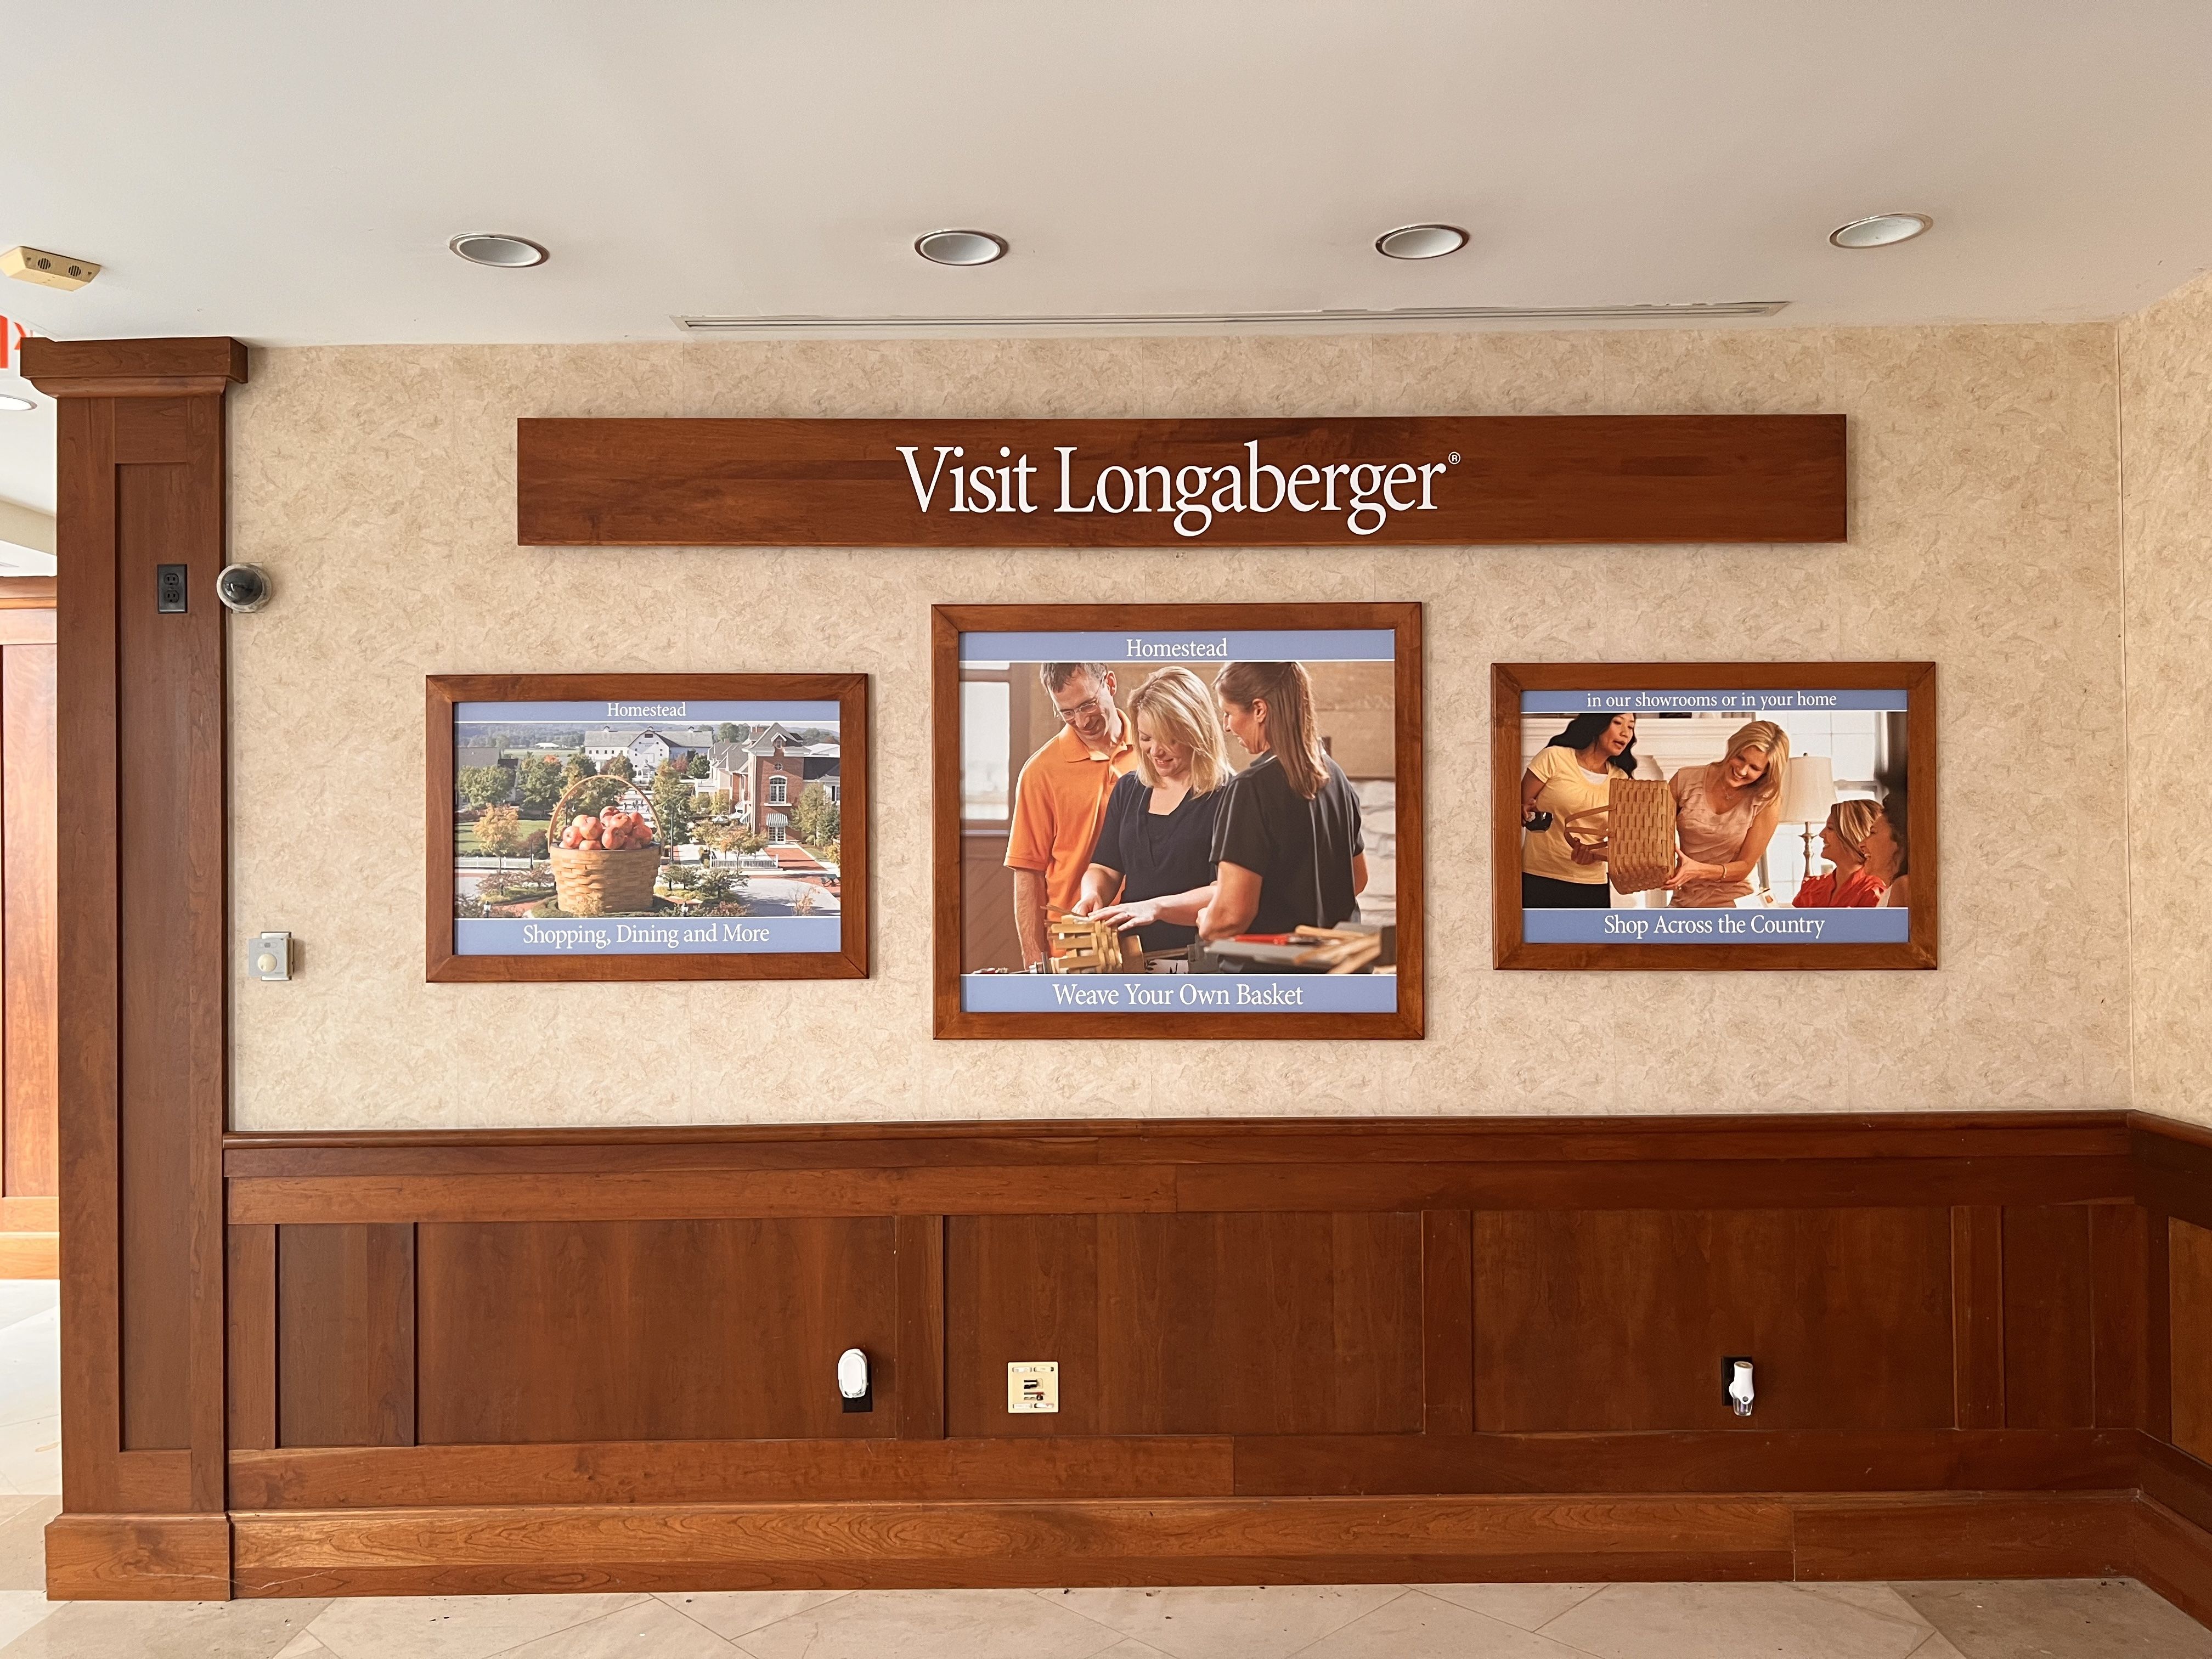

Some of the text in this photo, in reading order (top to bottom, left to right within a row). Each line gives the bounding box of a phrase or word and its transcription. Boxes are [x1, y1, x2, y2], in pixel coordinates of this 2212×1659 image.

[896, 447, 1037, 512] Visit
[1127, 637, 1228, 657] Homestead
[607, 702, 687, 716] Homestead
[1587, 691, 1837, 710] in our showrooms or in your home
[523, 923, 770, 949] Shopping, Dining and More
[1604, 914, 1825, 939] Shop Across the Country
[1052, 983, 1304, 1005] Weave Your Own Basket
